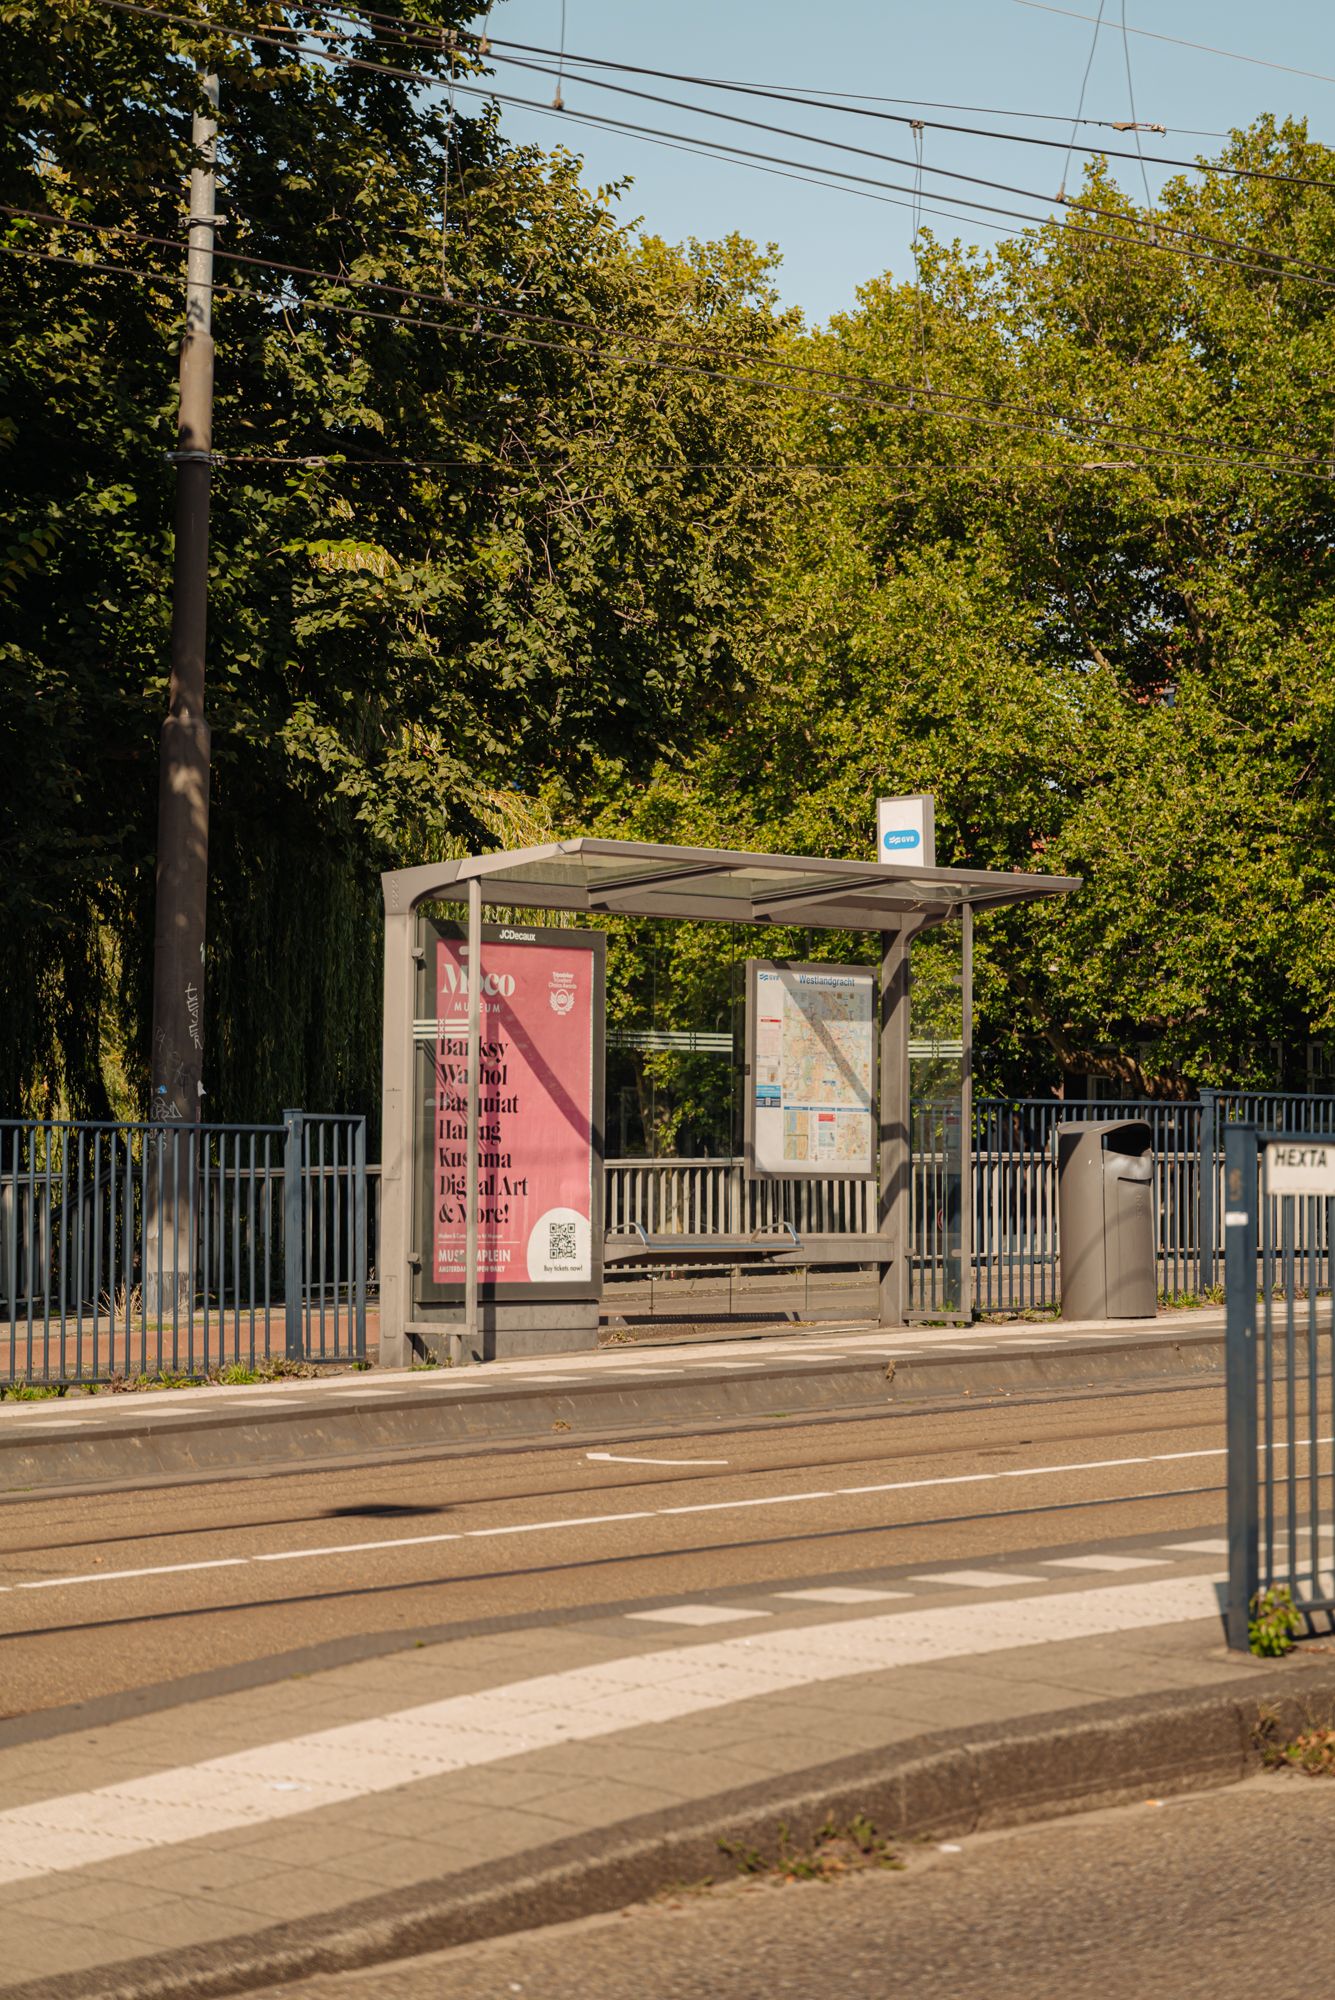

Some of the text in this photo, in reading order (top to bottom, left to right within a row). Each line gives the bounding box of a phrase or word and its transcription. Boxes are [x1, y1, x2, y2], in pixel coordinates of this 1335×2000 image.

[499, 929, 536, 942] JCDecaux
[441, 964, 516, 997] Mco
[799, 974, 855, 988] Westlandgracht
[454, 1002, 501, 1014] MUEUM
[440, 1036, 509, 1063] Baksy
[440, 1064, 507, 1086] Wahol
[1274, 1148, 1328, 1168] HEXTA
[440, 1173, 529, 1201] Digal Art
[439, 1203, 454, 1224] &
